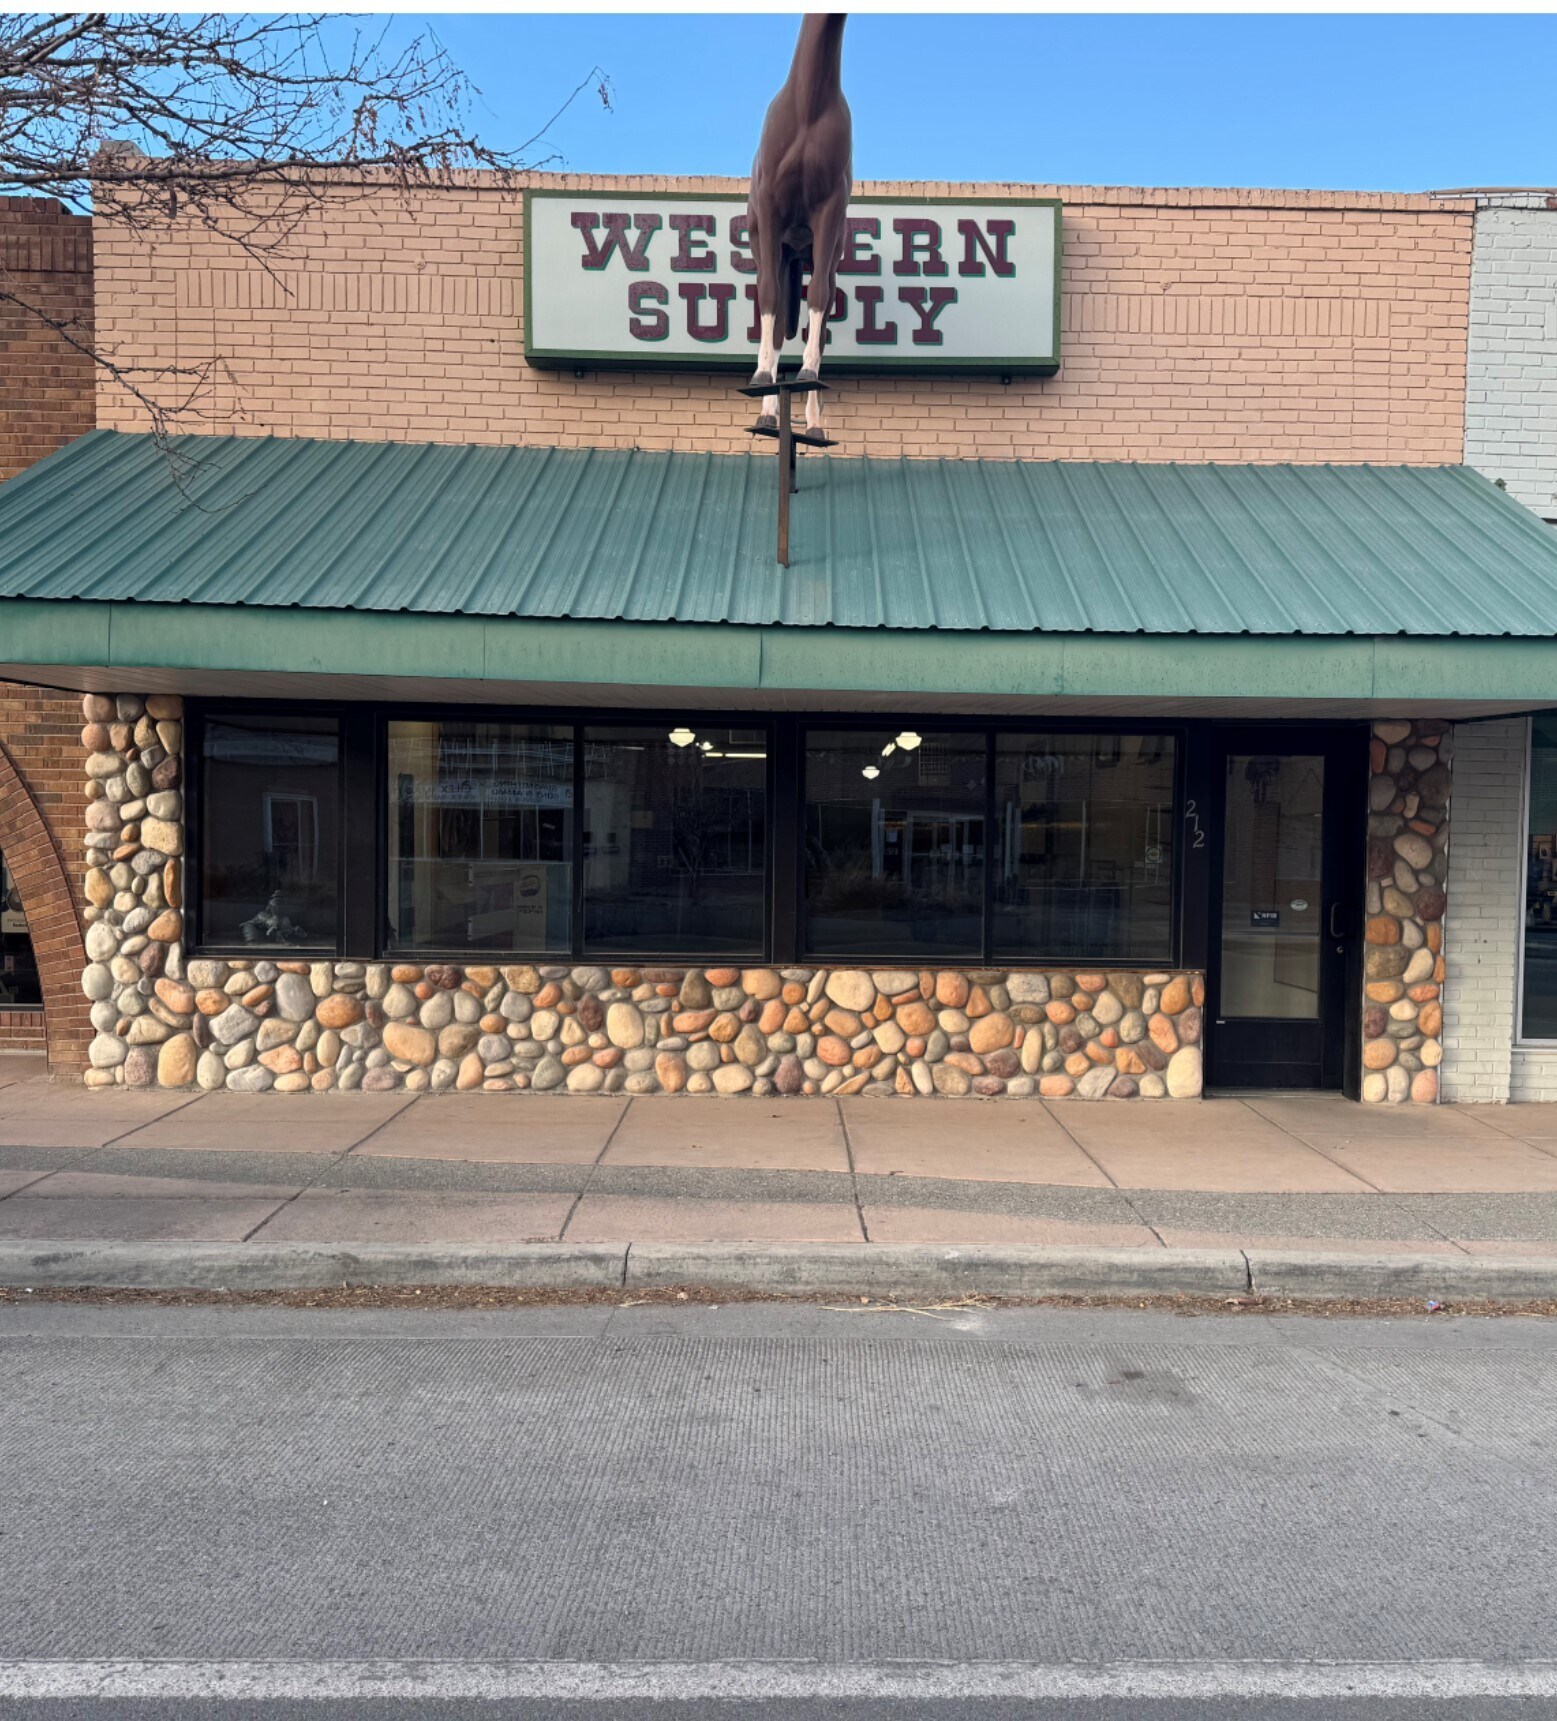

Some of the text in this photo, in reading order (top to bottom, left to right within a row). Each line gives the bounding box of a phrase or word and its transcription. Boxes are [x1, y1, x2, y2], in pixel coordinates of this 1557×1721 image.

[571, 212, 1016, 278] WESERN
[628, 280, 957, 345] SULY
[1185, 800, 1205, 848] 212
